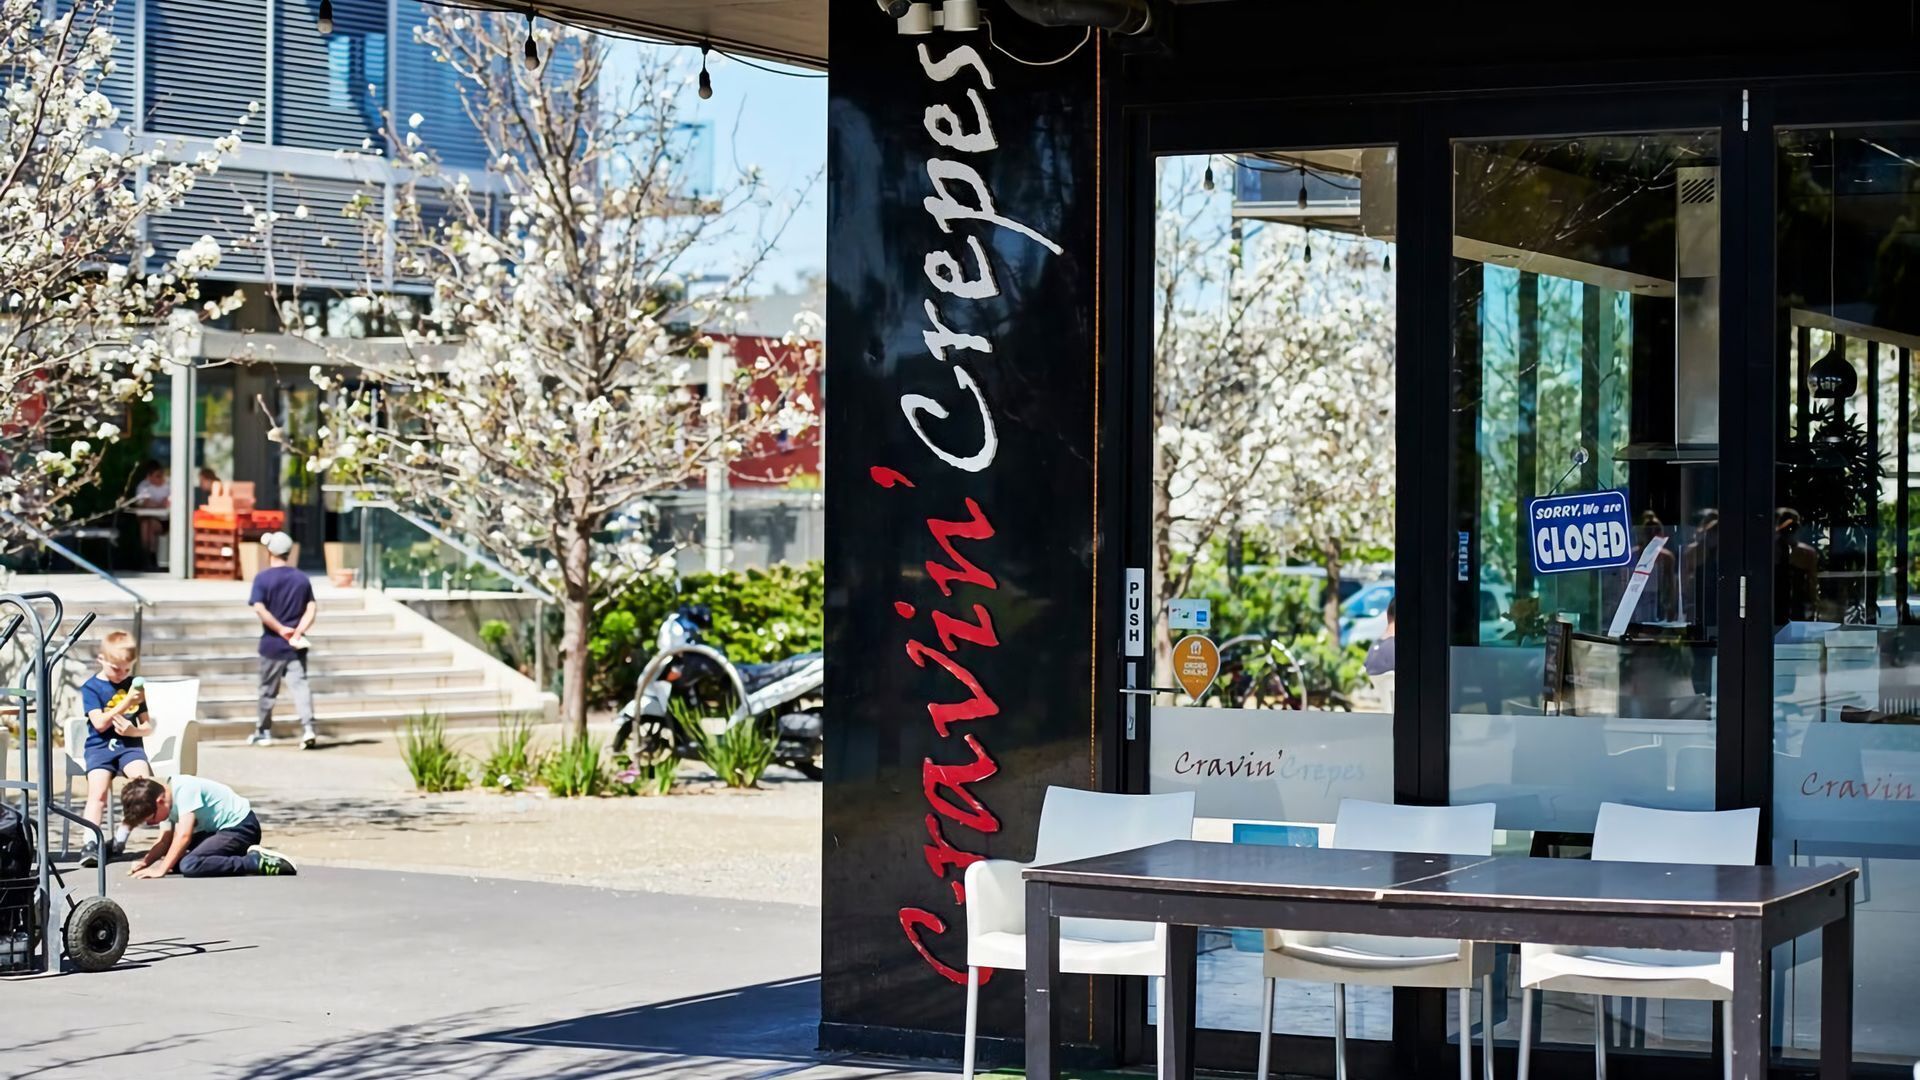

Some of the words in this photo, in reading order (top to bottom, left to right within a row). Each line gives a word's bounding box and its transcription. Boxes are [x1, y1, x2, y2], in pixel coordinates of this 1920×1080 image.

[901, 43, 1064, 473] Crepes
[1583, 504, 1599, 515] We
[1603, 504, 1621, 513] are
[1537, 521, 1626, 564] CLOSED
[1129, 582, 1139, 641] PUSH
[1175, 750, 1283, 777] Cravin'
[1801, 772, 1915, 799] Cravin
